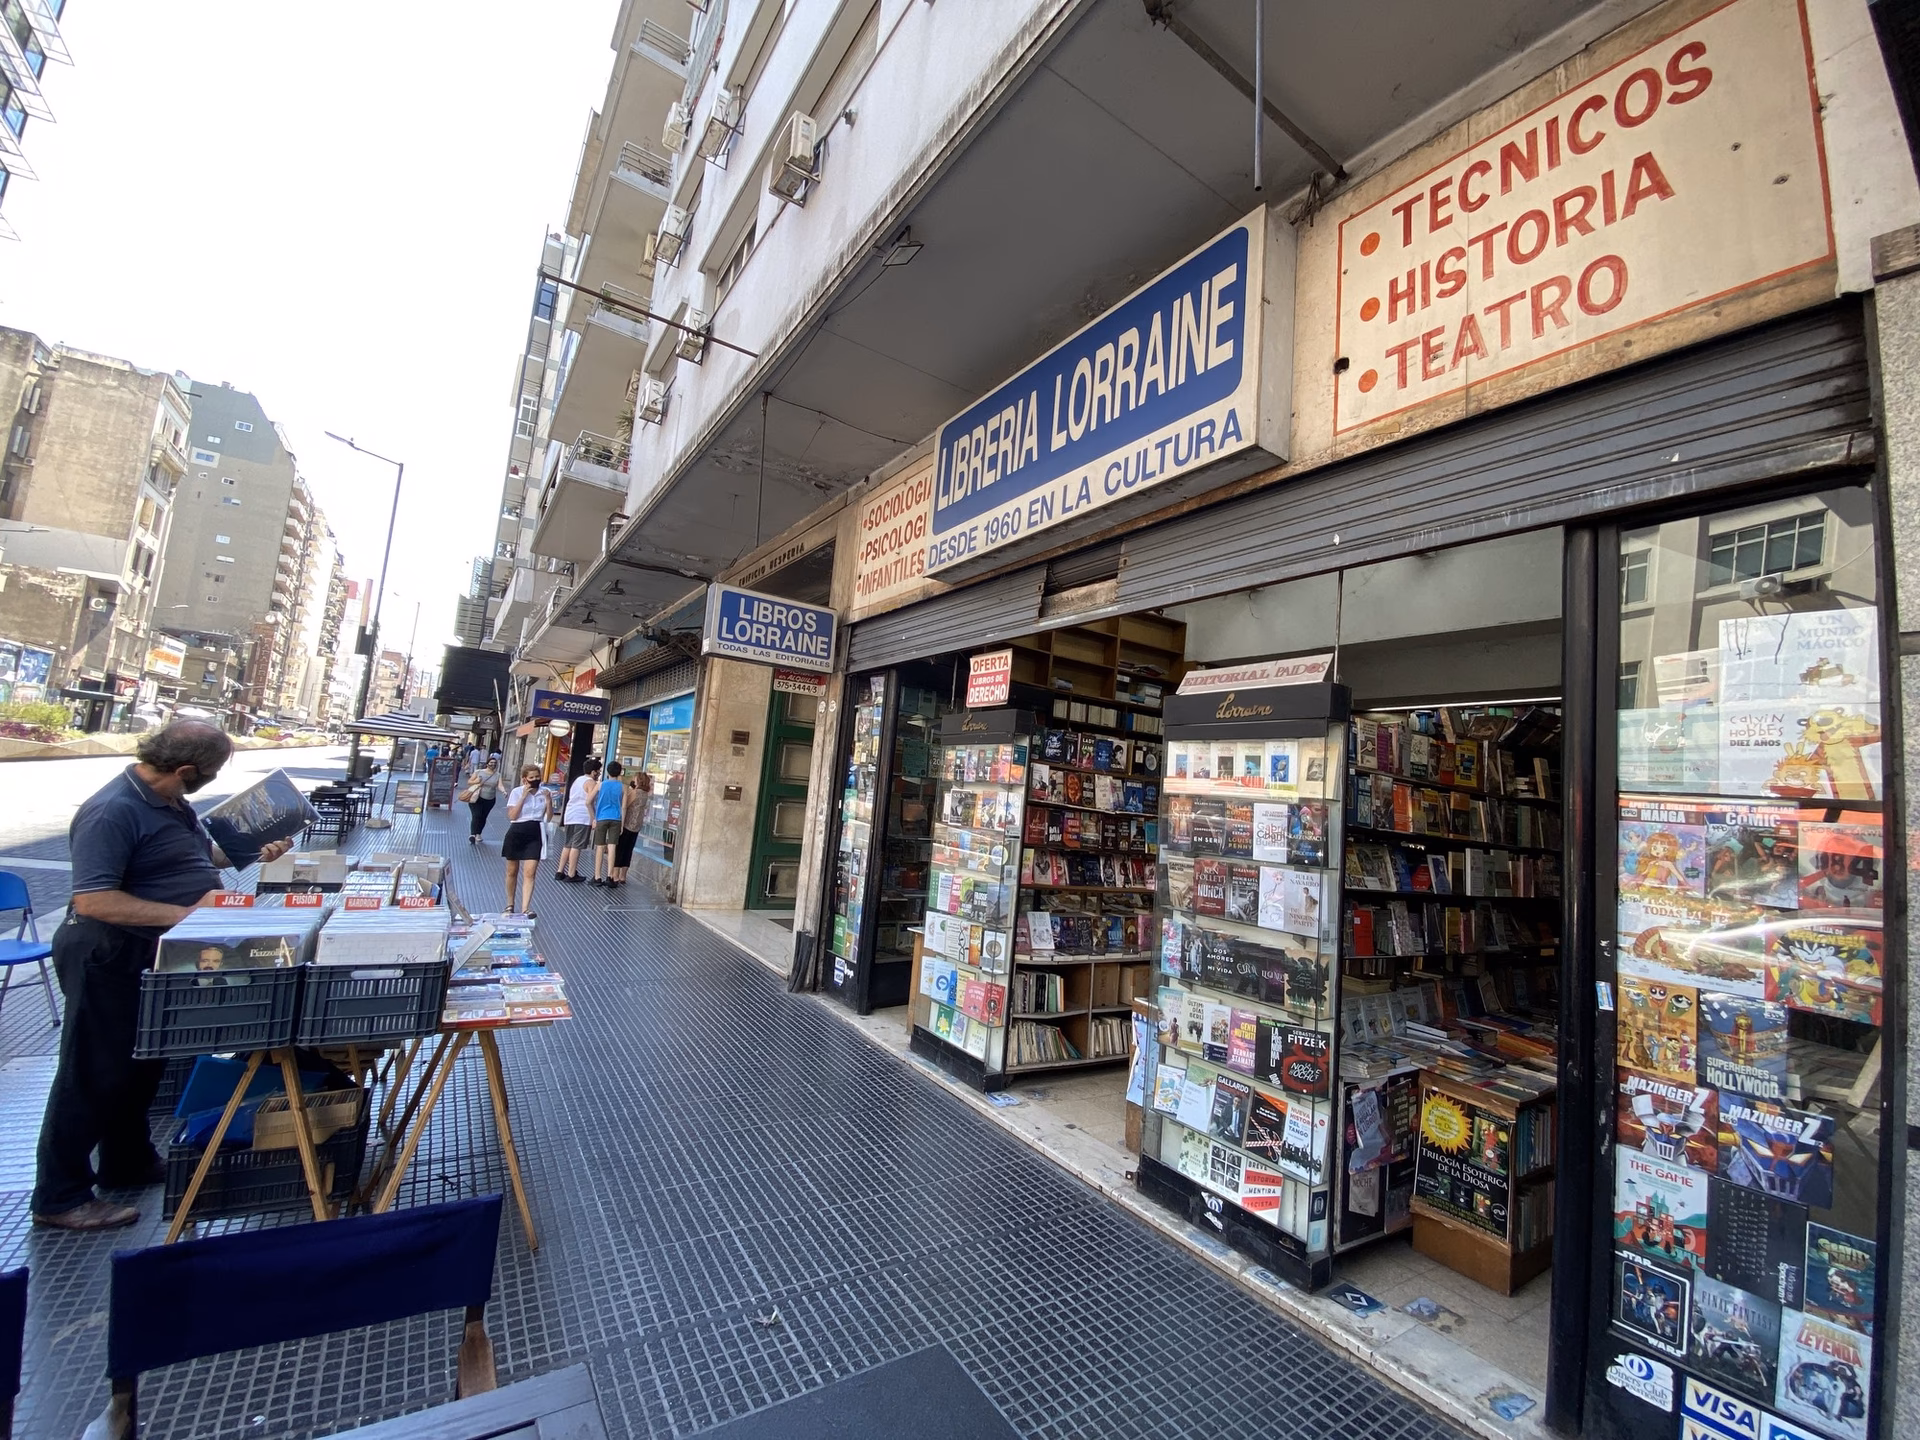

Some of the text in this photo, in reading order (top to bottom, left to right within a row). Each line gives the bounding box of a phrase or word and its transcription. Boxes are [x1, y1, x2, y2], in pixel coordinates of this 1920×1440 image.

[1392, 41, 1713, 247] TECNICOS
[1388, 151, 1675, 324] HISTORIA
[1385, 254, 1628, 391] TEATRO
[937, 262, 1237, 511] LIBRERIA LORRAINE
[928, 408, 1243, 569] DESDE 1960 EN LA CULTURA
[739, 565, 766, 587] EDIFICIO
[861, 548, 925, 597] INFANTILES
[739, 598, 817, 632] LIBROS
[1818, 615, 1844, 626] UN
[721, 617, 829, 656] LORRAINE
[1797, 625, 1864, 639] MUNDO
[1797, 636, 1866, 650] MÁGICO
[717, 642, 830, 668] TODAS LAS EDITORIALES
[972, 654, 1010, 674] OFERTA
[972, 674, 1004, 686] LIBROS DE
[1182, 668, 1270, 687] EDITORIAL
[968, 684, 1008, 704] DERECHO
[562, 708, 600, 716] ARGENTINO
[564, 701, 602, 713] CORREO
[1215, 693, 1273, 719] Lorraine
[1729, 738, 1781, 747] DIEZ AÑOS
[1640, 808, 1686, 823] MANGA
[1195, 872, 1226, 884] FOLLETT
[1204, 866, 1219, 875] KEN
[1295, 874, 1314, 882] JULIA
[1197, 884, 1224, 899] NUNCA
[1290, 879, 1320, 888] NAVARRO
[221, 895, 246, 906] JAZZ
[291, 895, 317, 905] FUSION
[347, 898, 378, 909] HARDROCK
[403, 897, 431, 908] ROCK
[1642, 905, 1732, 925] TODAS PATES
[1206, 954, 1234, 963] AMORES
[1216, 967, 1233, 975] VIDA
[1287, 1034, 1327, 1050] FITZEK
[1706, 1057, 1770, 1079] SUPERHEROES
[1217, 1075, 1249, 1094] GALLARDO
[1706, 1066, 1779, 1099] HOLLYWOOD
[1626, 1075, 1711, 1115] MAZINGER Z
[1290, 1107, 1311, 1118] NUEVA
[1290, 1113, 1319, 1129] HISTORA
[1288, 1126, 1309, 1138] TANGO
[1289, 1119, 1300, 1129] DEL
[1728, 1104, 1821, 1146] MAZINGER Z
[1246, 1174, 1276, 1183] HISTORIA
[1421, 1147, 1509, 1191] TRILOGÍA ESOTÉRICA
[1437, 1163, 1490, 1192] DE LA DIOSA
[1628, 1159, 1694, 1188] THE GAME
[1615, 1250, 1653, 1268] STAR
[1702, 1290, 1773, 1332] FINAL FANTASY
[1647, 1336, 1686, 1358] WARS
[1608, 1366, 1668, 1400] Diners Club
[1692, 1387, 1755, 1433] VISA
